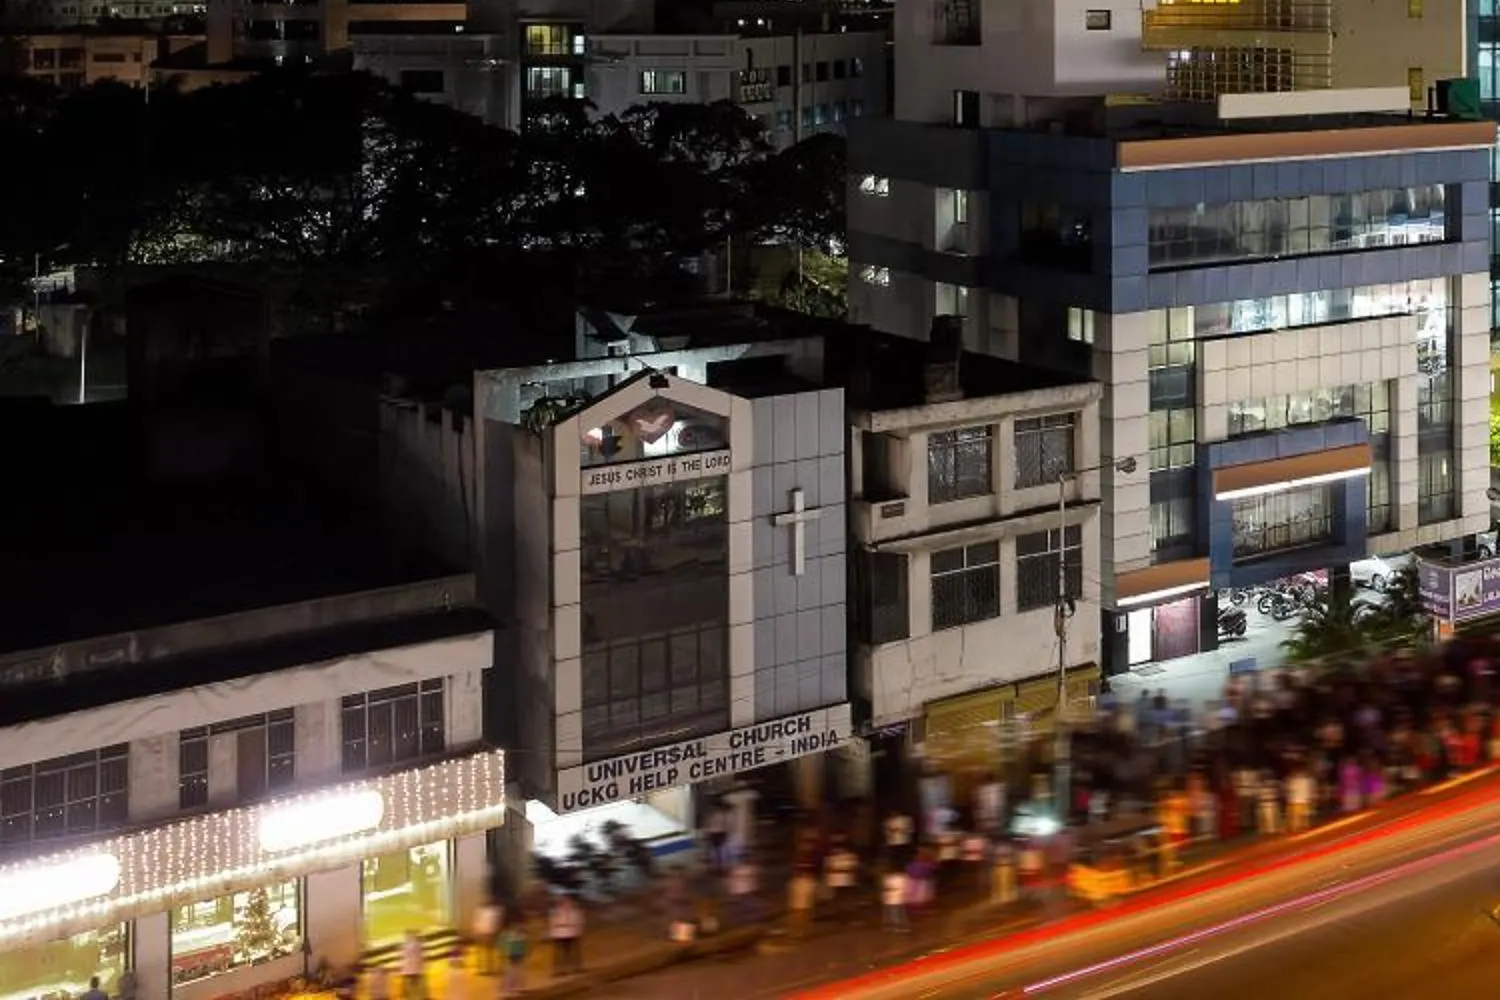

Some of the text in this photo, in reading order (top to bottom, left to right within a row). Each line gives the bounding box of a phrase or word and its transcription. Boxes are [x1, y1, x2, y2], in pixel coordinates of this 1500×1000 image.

[589, 455, 731, 486] JESUS CHRIST IS THE LORD
[563, 783, 619, 810] UCKG
[629, 768, 679, 794] HELP
[689, 748, 766, 780] CENTRE
[791, 729, 839, 755] INDIA
[588, 716, 811, 783] UNIVERSAL CHURCH
